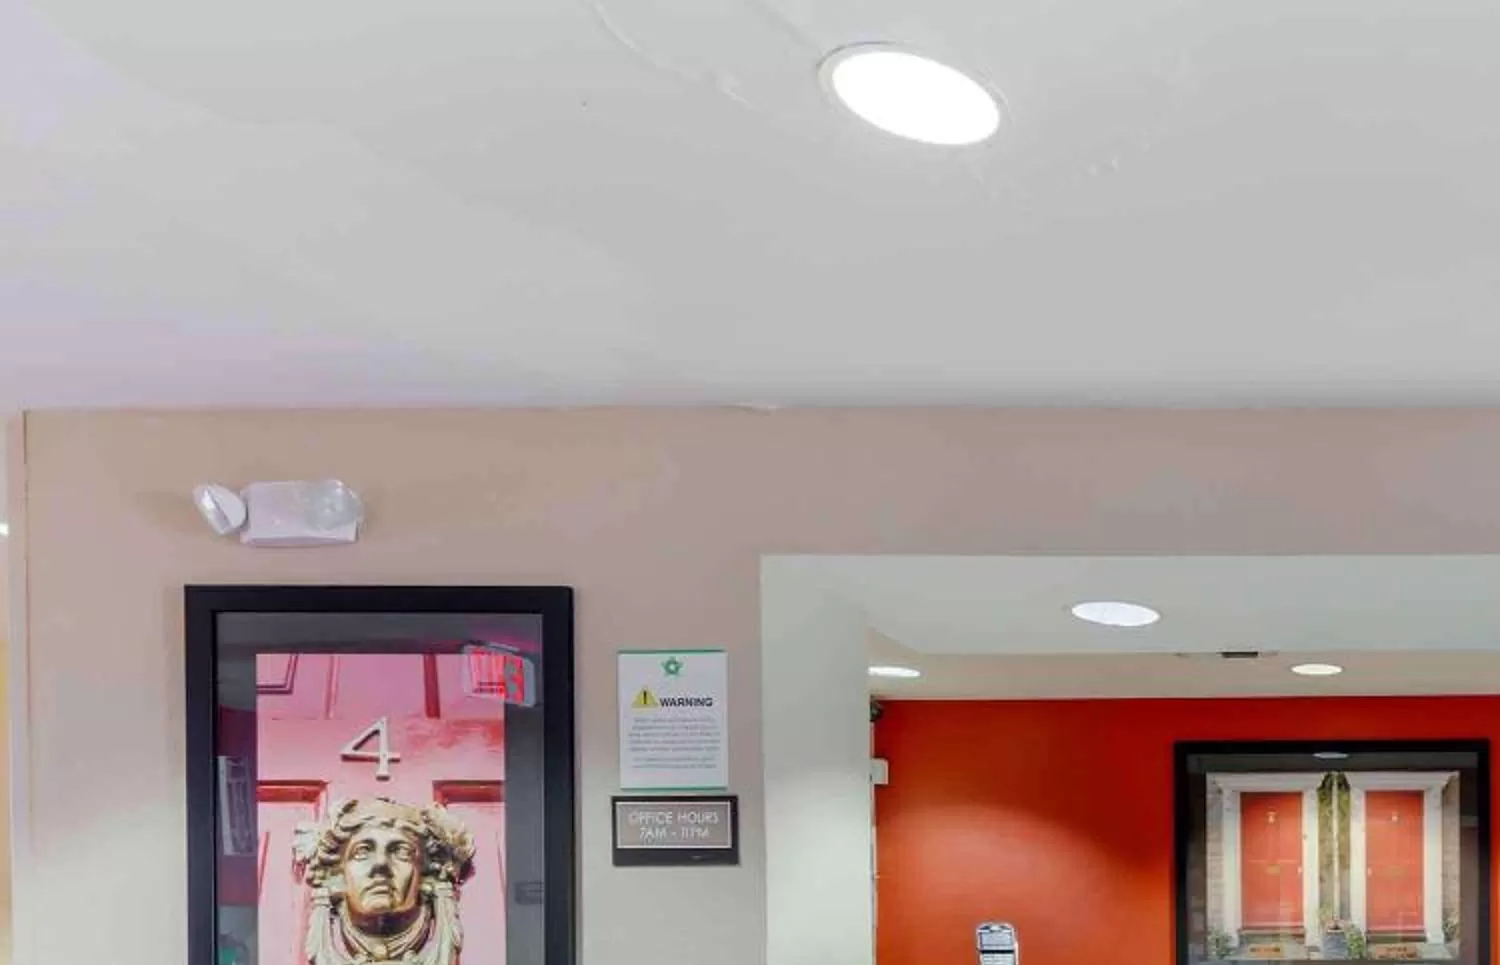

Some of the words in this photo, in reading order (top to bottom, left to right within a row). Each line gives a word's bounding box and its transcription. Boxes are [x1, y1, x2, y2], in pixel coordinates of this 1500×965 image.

[659, 697, 713, 708] WARNING
[340, 716, 401, 781] 4
[628, 811, 673, 825] OFFICE
[677, 811, 719, 825] HOURS
